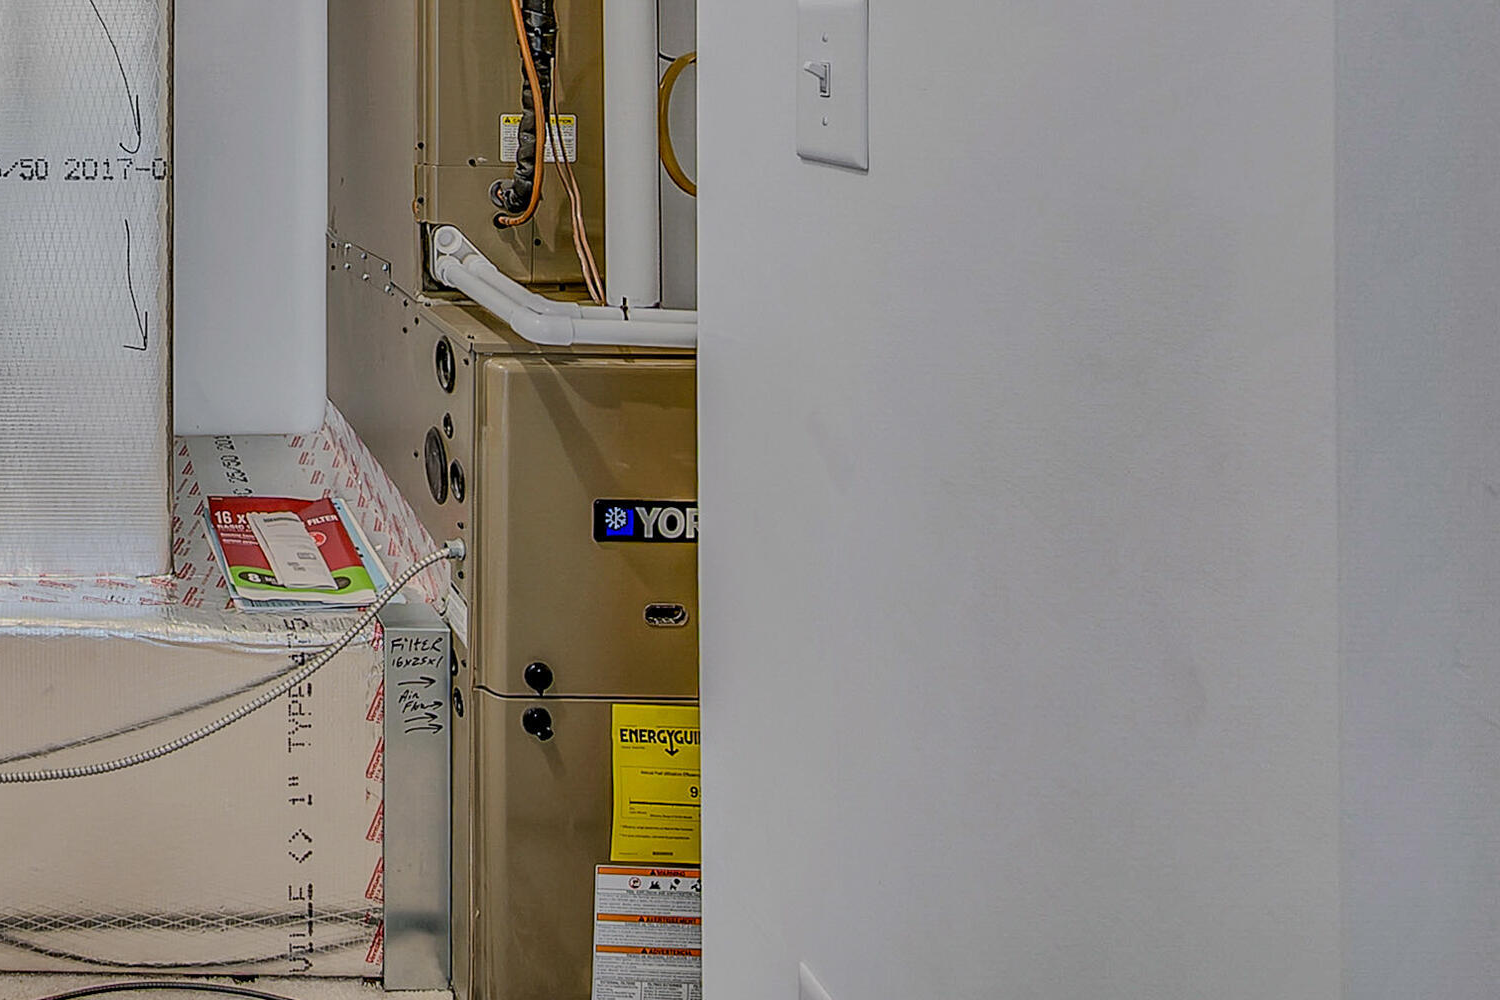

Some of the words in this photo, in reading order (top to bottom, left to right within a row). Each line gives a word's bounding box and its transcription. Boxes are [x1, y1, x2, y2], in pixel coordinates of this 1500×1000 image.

[63, 158, 167, 181] 2017-0
[215, 511, 232, 525] 16
[307, 514, 338, 527] FILTER
[248, 572, 262, 584] 8
[392, 655, 444, 668] 16x25x1
[288, 682, 313, 754] TYPE
[620, 728, 700, 752] ENERGYGUI
